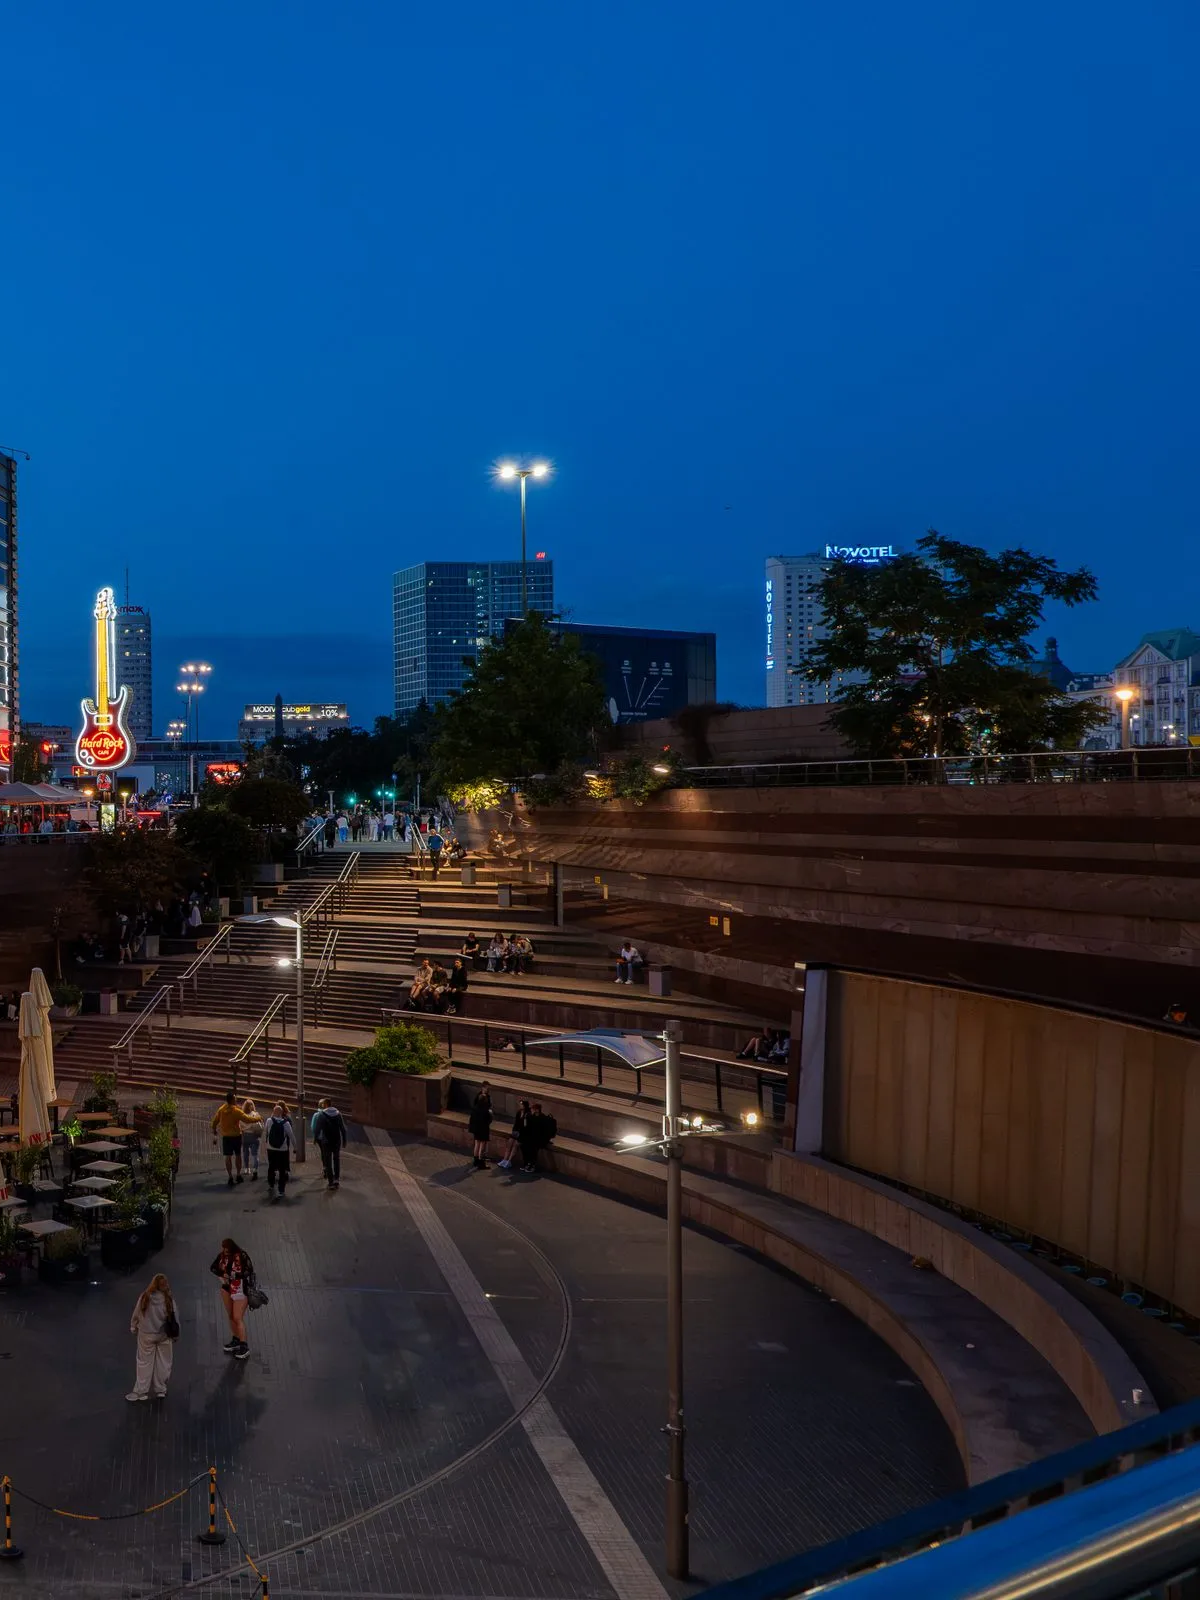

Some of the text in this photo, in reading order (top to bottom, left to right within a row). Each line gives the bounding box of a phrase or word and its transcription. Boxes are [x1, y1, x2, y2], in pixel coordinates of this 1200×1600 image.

[825, 544, 899, 558] NOVOTEL
[253, 705, 275, 713] MODIV
[320, 709, 339, 717] 10%
[81, 737, 124, 749] Hard Rock
